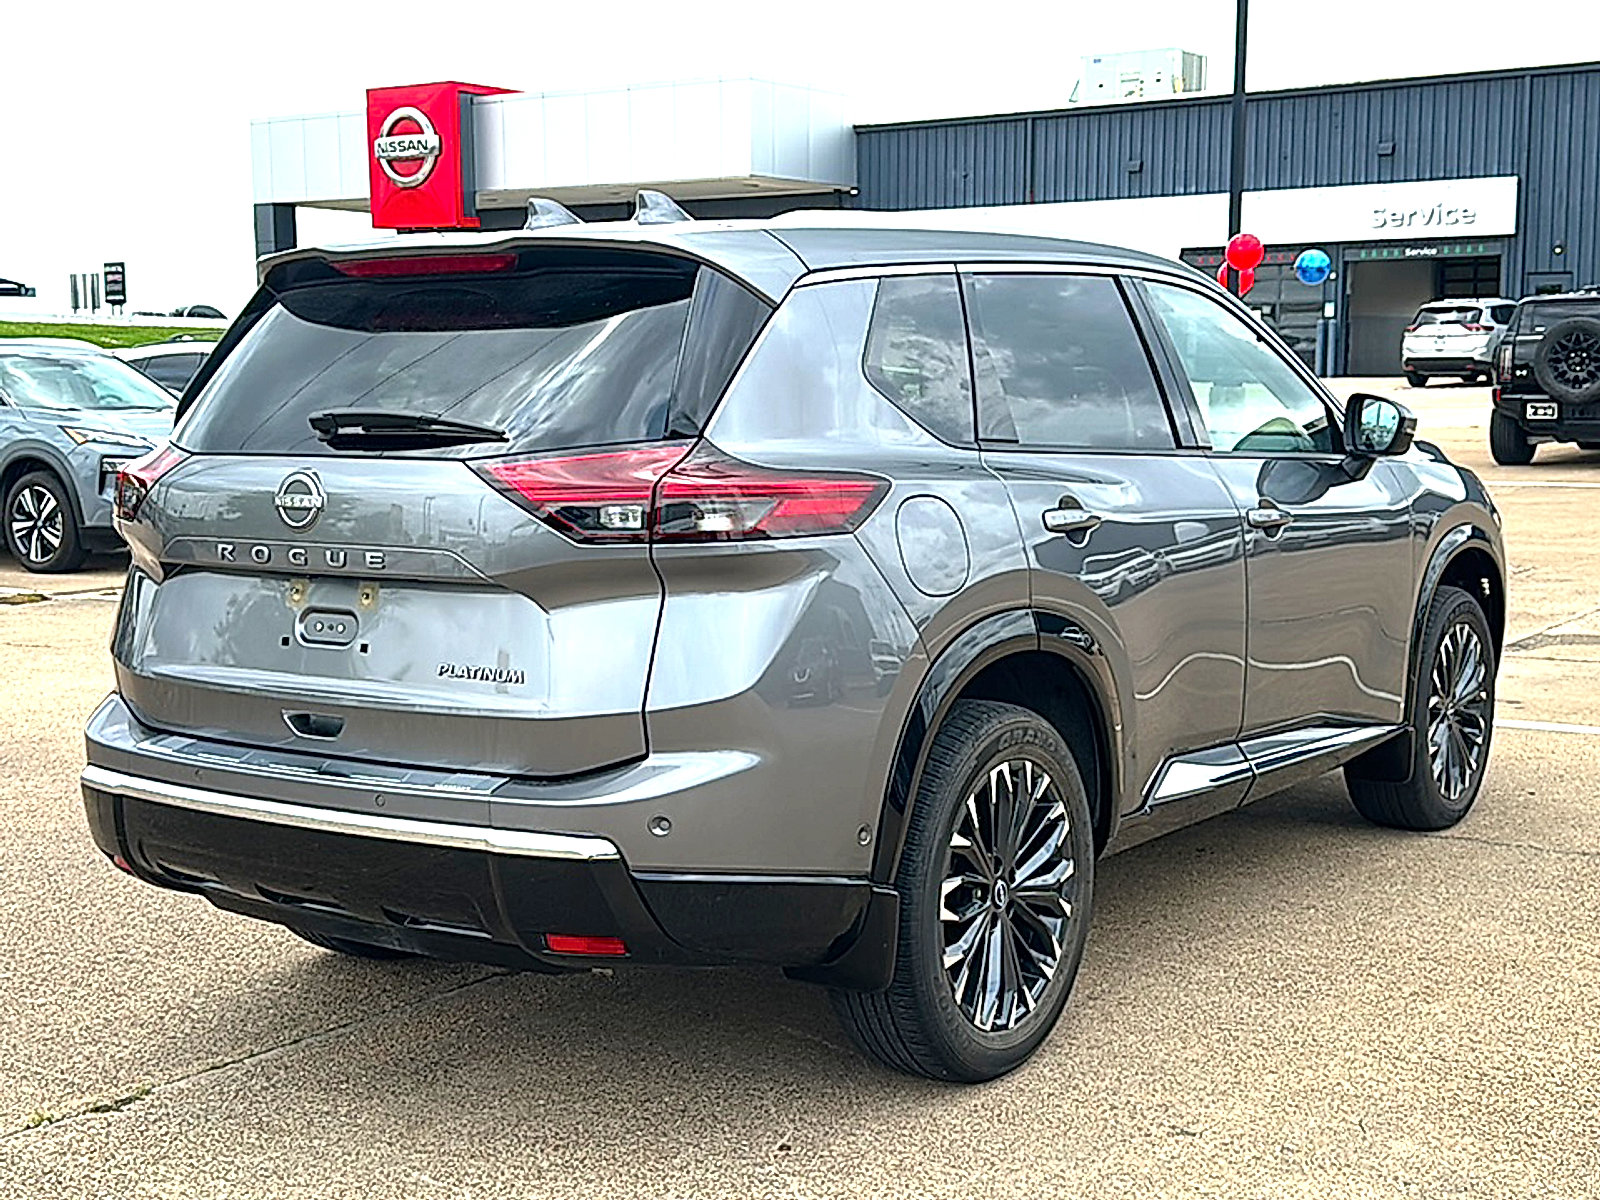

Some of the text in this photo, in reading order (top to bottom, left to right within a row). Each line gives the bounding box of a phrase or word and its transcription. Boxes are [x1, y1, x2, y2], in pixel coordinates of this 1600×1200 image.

[376, 139, 429, 154] NISSAN
[1371, 202, 1477, 229] Service
[1404, 246, 1438, 257] Service
[276, 495, 322, 507] NISSAN
[216, 543, 387, 570] ROGUE
[437, 663, 525, 685] PLATINUM
